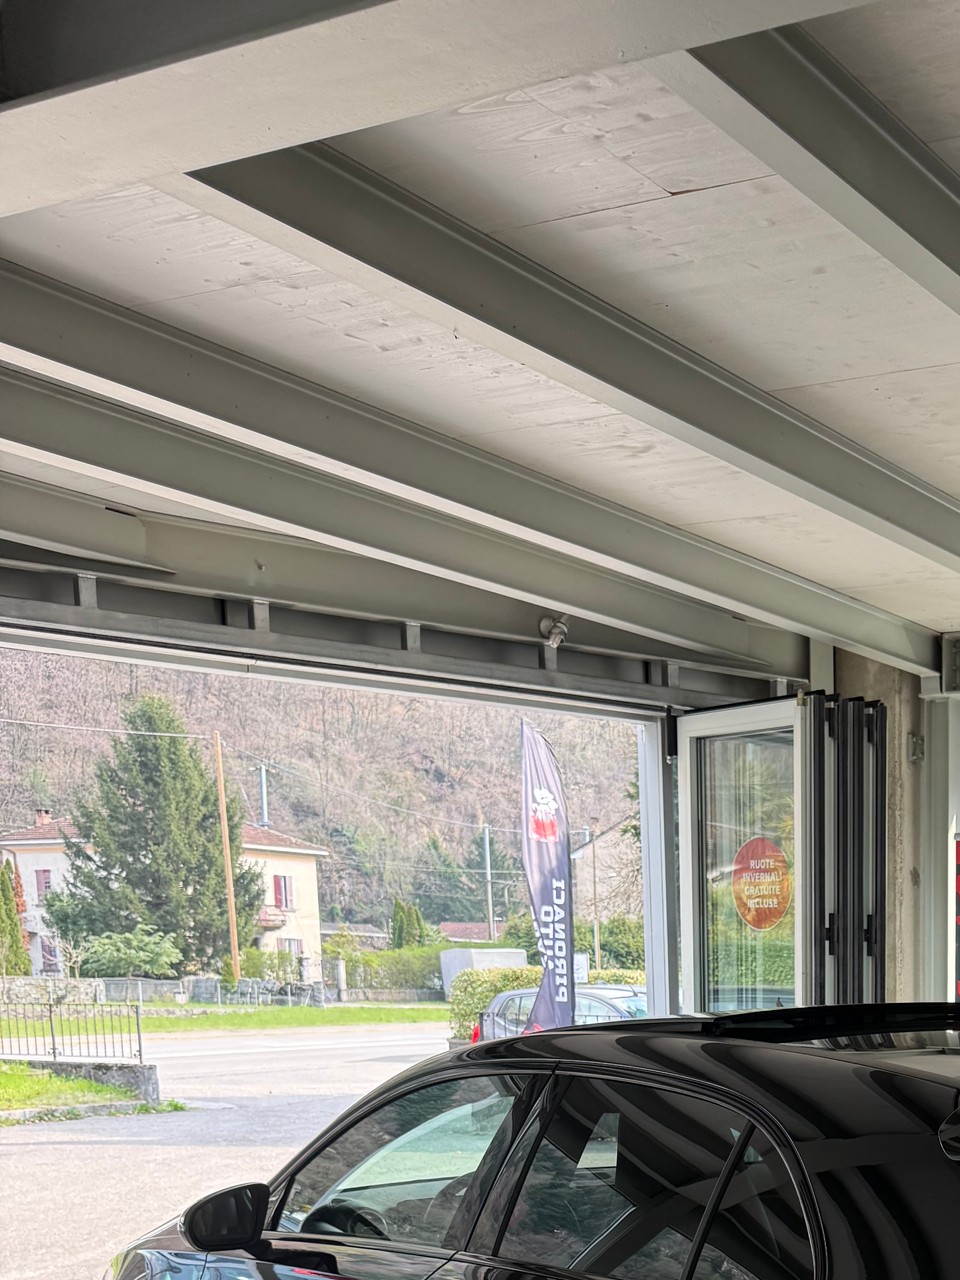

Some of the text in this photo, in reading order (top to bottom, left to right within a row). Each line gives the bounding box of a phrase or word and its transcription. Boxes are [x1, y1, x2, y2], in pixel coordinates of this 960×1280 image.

[749, 859, 775, 870] RUOTE
[743, 872, 783, 882] INVERNALI
[744, 885, 781, 896] GRATUITE
[747, 898, 778, 908] INCLUSE
